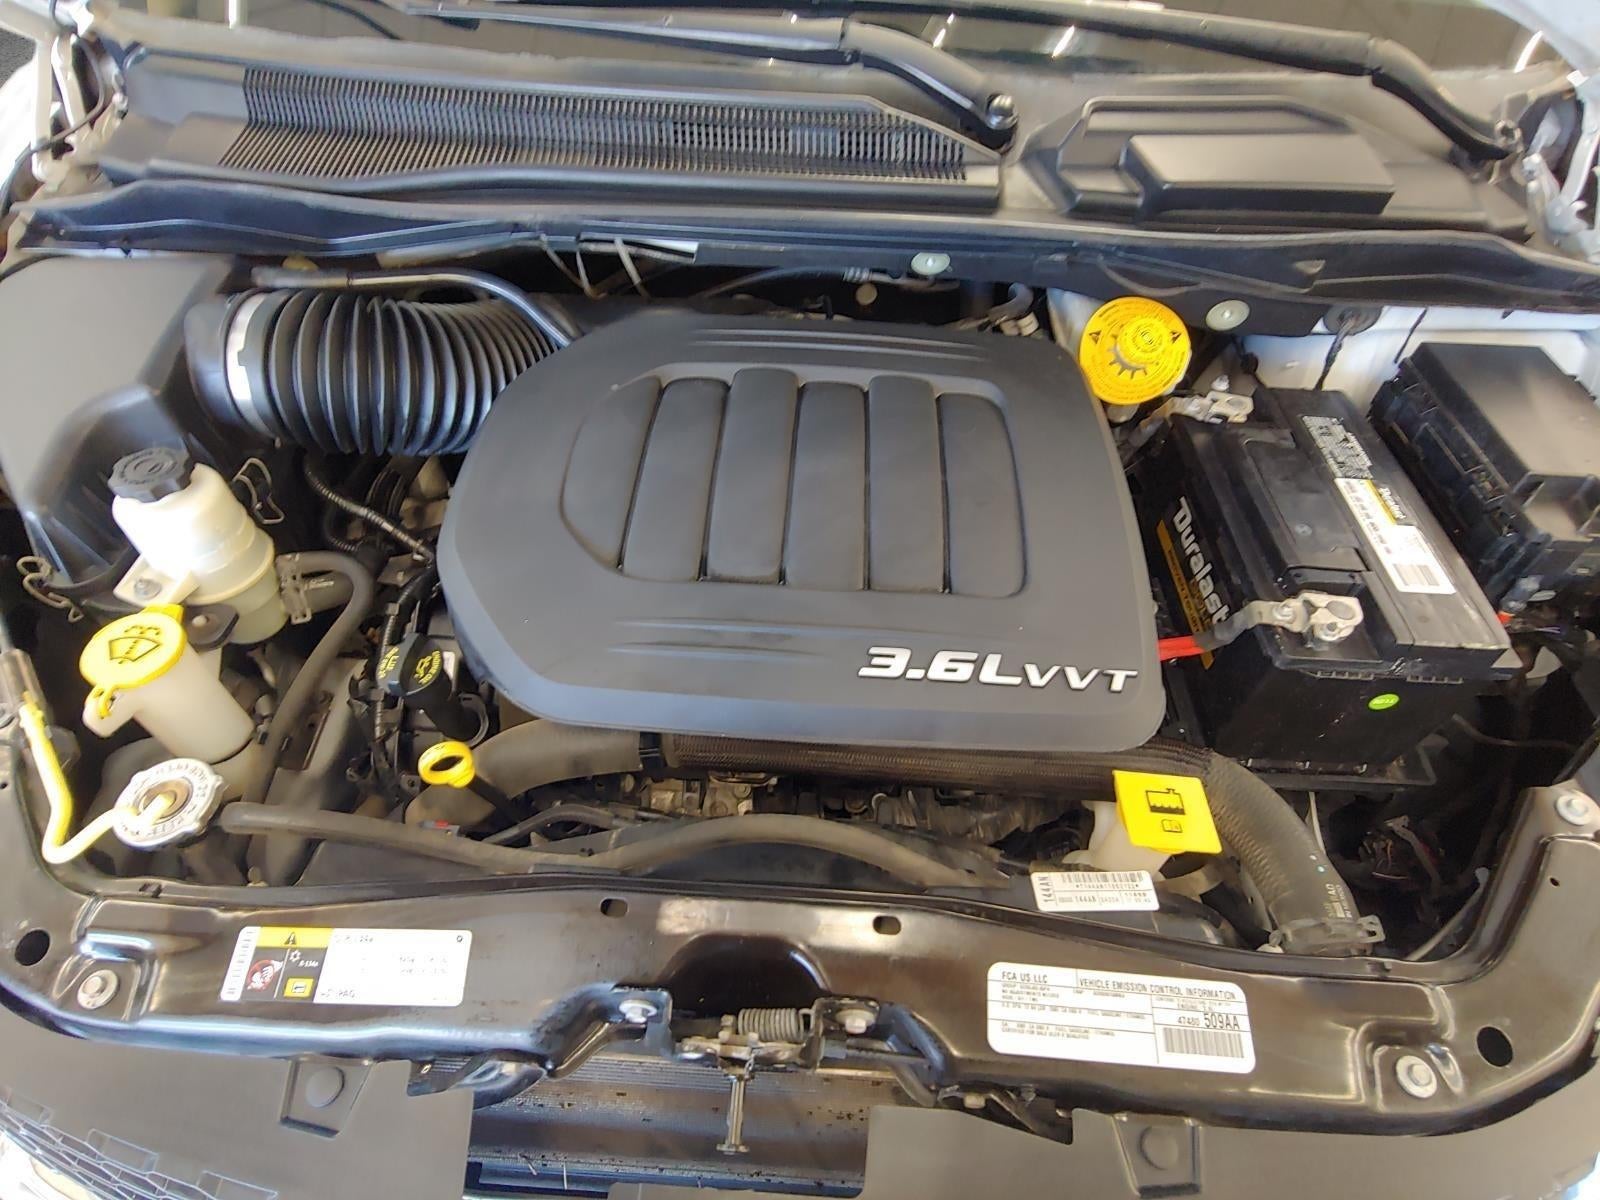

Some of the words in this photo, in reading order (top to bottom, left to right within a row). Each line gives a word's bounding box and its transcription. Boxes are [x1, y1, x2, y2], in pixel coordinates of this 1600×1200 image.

[1172, 495, 1231, 626] Duralast
[858, 646, 1023, 686] 3.6L
[1024, 663, 1139, 692] VVT
[1001, 971, 1017, 981] FCA
[1020, 973, 1031, 982] US
[1033, 974, 1048, 984] LLC
[1079, 978, 1110, 990] VEHICLE
[1112, 981, 1148, 993] EMISSION
[1150, 984, 1183, 996] CONTROL
[1185, 987, 1237, 1000] INFORMATION
[1203, 1012, 1241, 1030] 509AA
